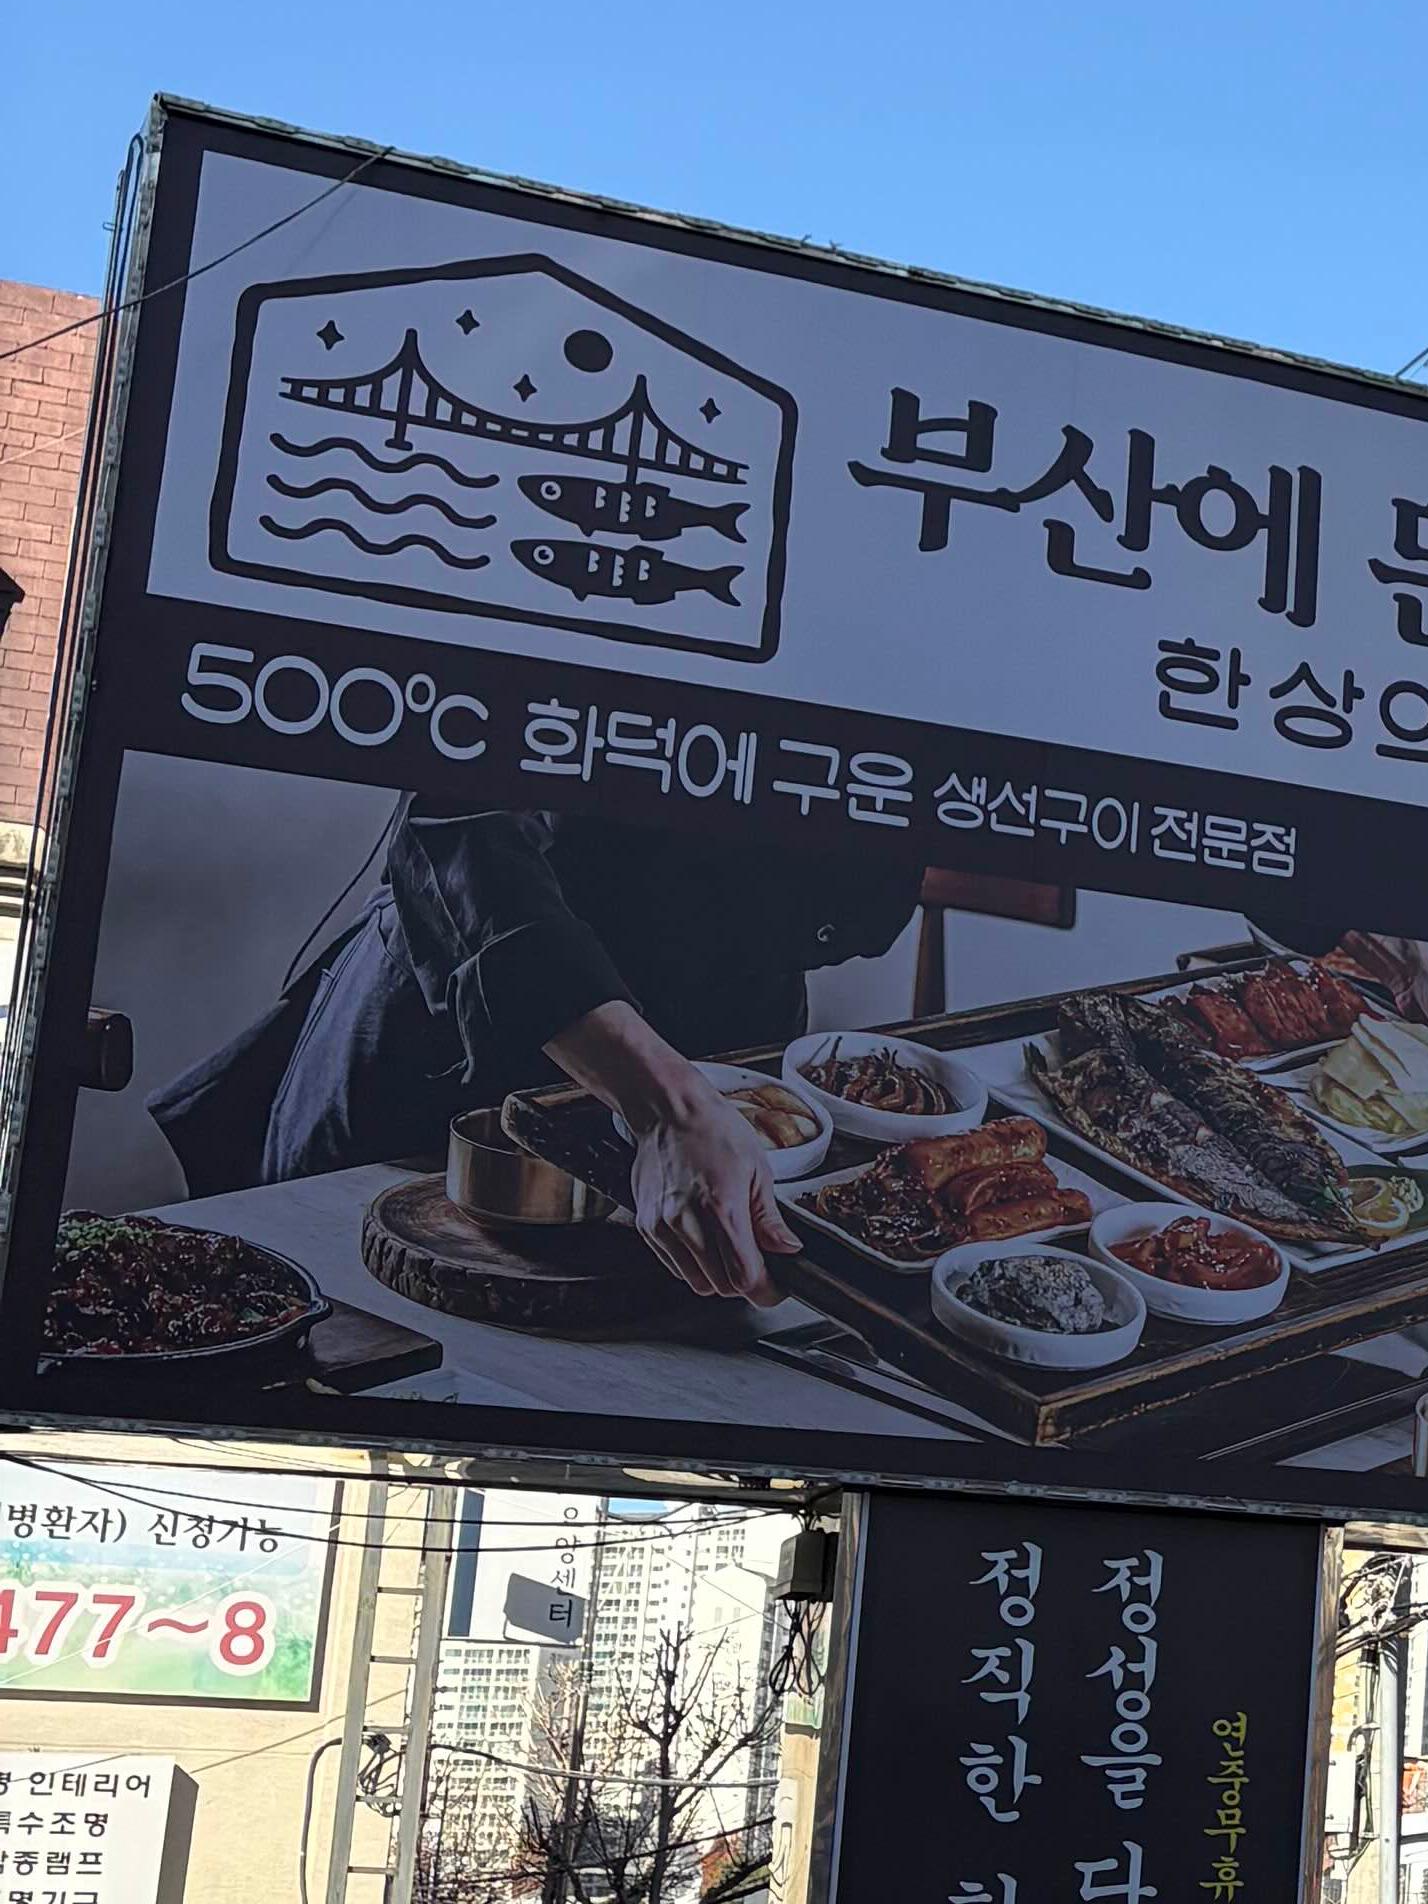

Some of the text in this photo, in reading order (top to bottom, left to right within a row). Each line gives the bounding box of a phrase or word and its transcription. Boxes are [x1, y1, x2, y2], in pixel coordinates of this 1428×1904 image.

[847, 386, 1324, 629] 부산에
[518, 696, 758, 804] 화덕에
[773, 739, 913, 828] 구운
[934, 768, 1142, 855] 생선구이
[1149, 807, 1299, 879] 전문점
[29, 1771, 151, 1798] 인테리어
[959, 1542, 1043, 1824] 정직한
[1080, 1549, 1164, 1811] 정성을
[1199, 1711, 1249, 1904] 연중무휴
